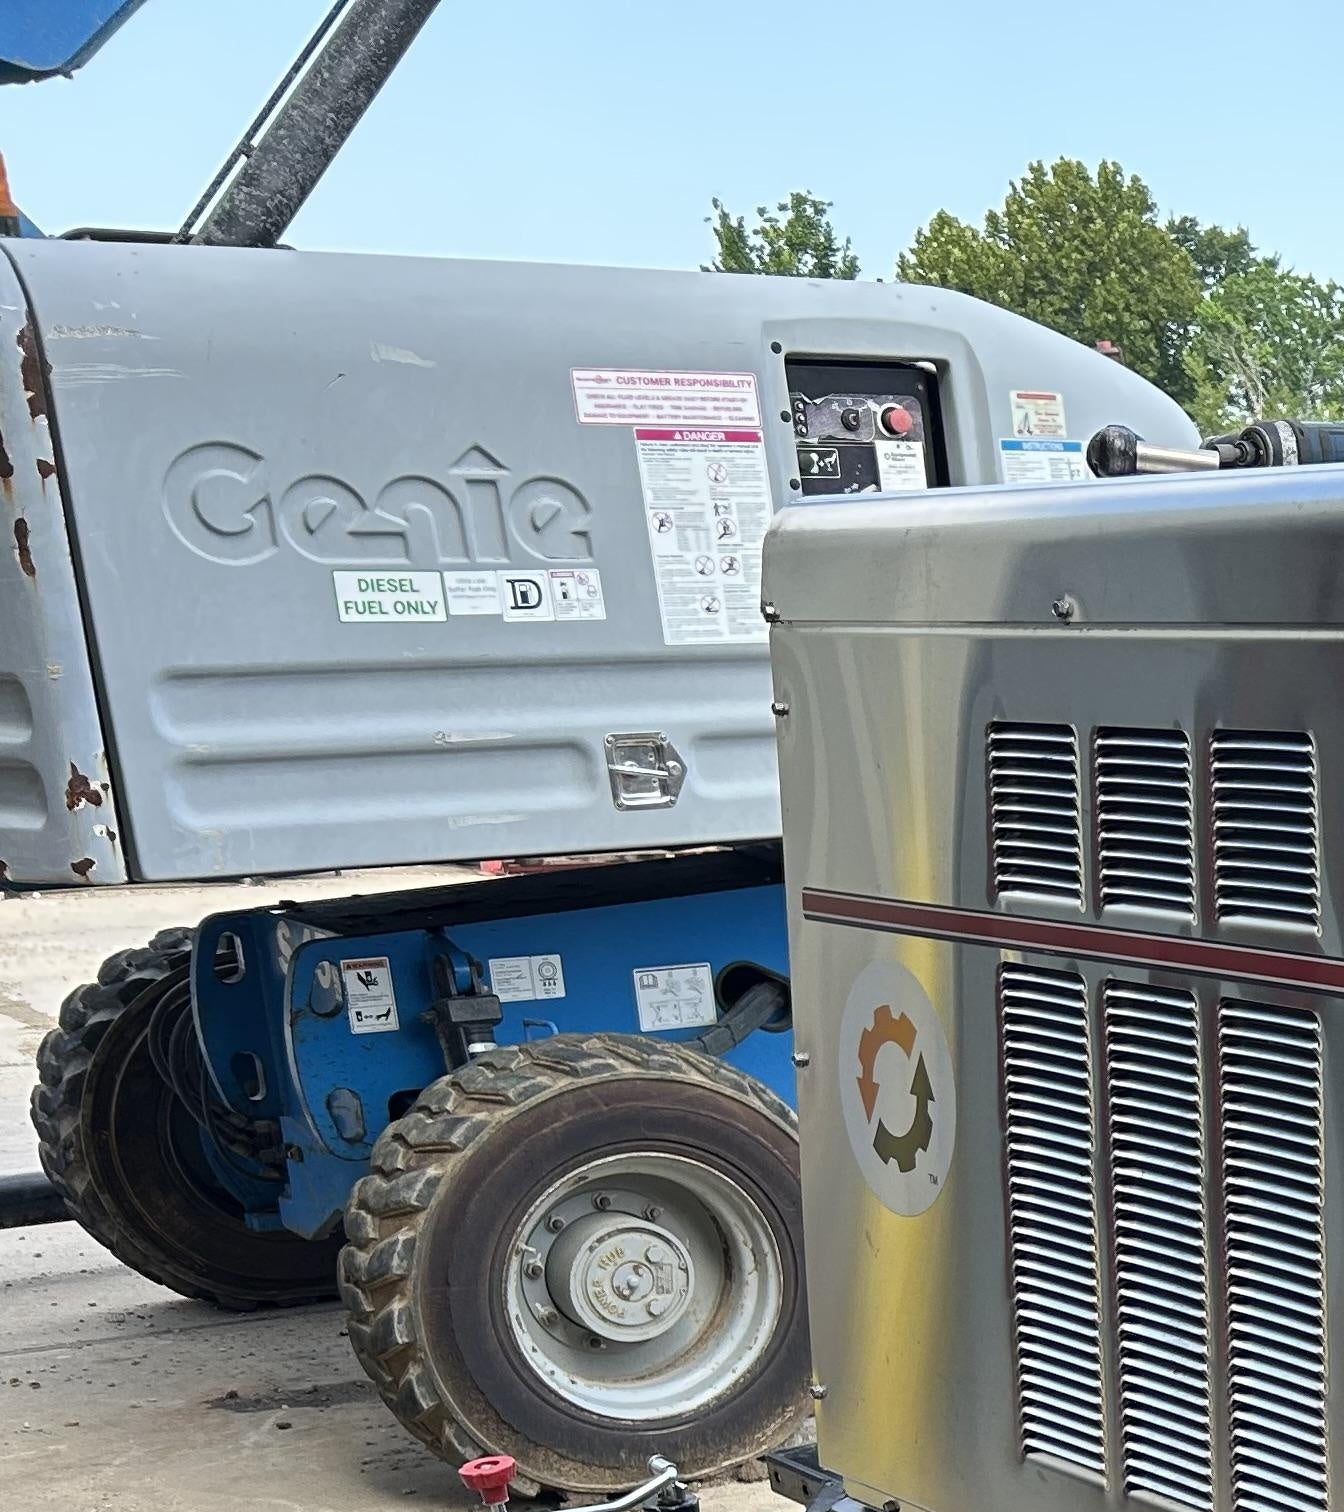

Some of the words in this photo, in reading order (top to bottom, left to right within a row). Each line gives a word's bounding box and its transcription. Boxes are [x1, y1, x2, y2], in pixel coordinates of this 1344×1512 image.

[162, 440, 595, 566] Genie
[357, 578, 420, 593] DIESEL
[344, 600, 389, 615] FUEL
[393, 600, 438, 616] ONLY
